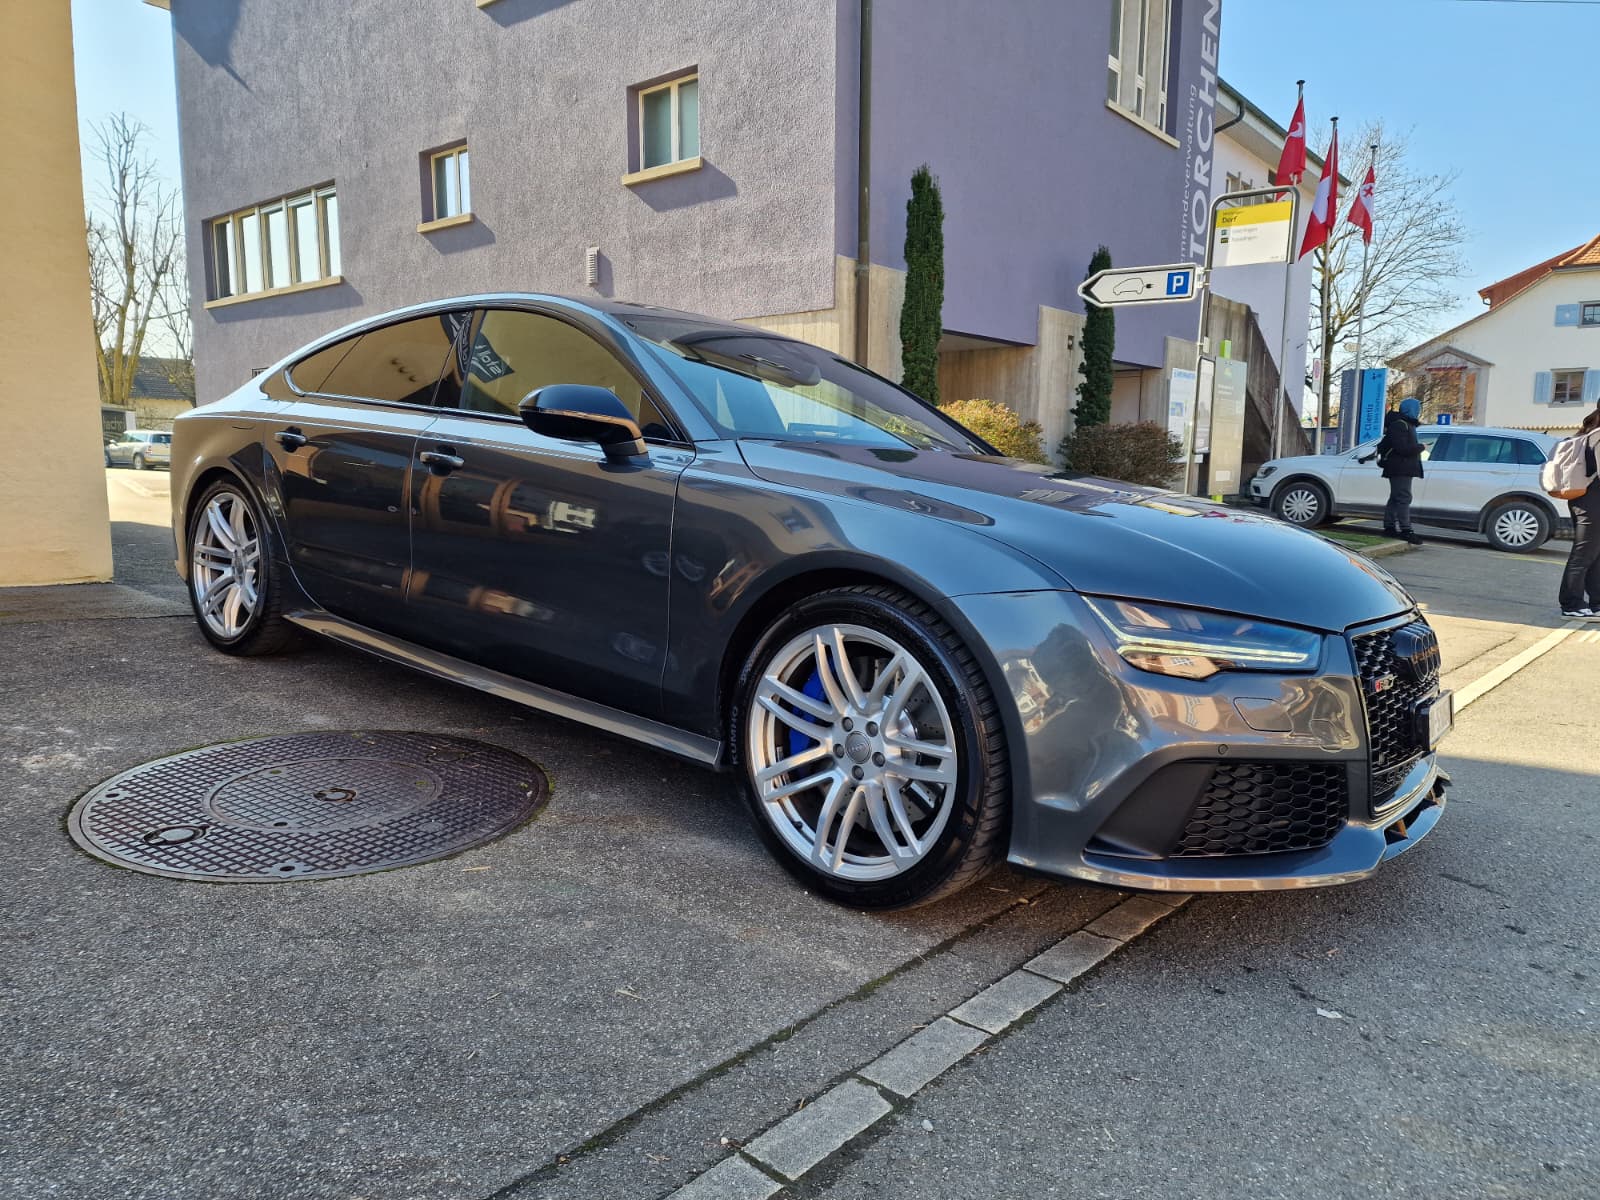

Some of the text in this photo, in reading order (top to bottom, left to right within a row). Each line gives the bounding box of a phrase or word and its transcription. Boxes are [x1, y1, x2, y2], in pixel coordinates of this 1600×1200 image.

[1188, 0, 1220, 259] TORCHEN
[1180, 83, 1197, 263] meindeverwaltung
[1222, 216, 1238, 224] Dorf
[1172, 275, 1184, 293] P
[730, 706, 738, 765] KUMHO
